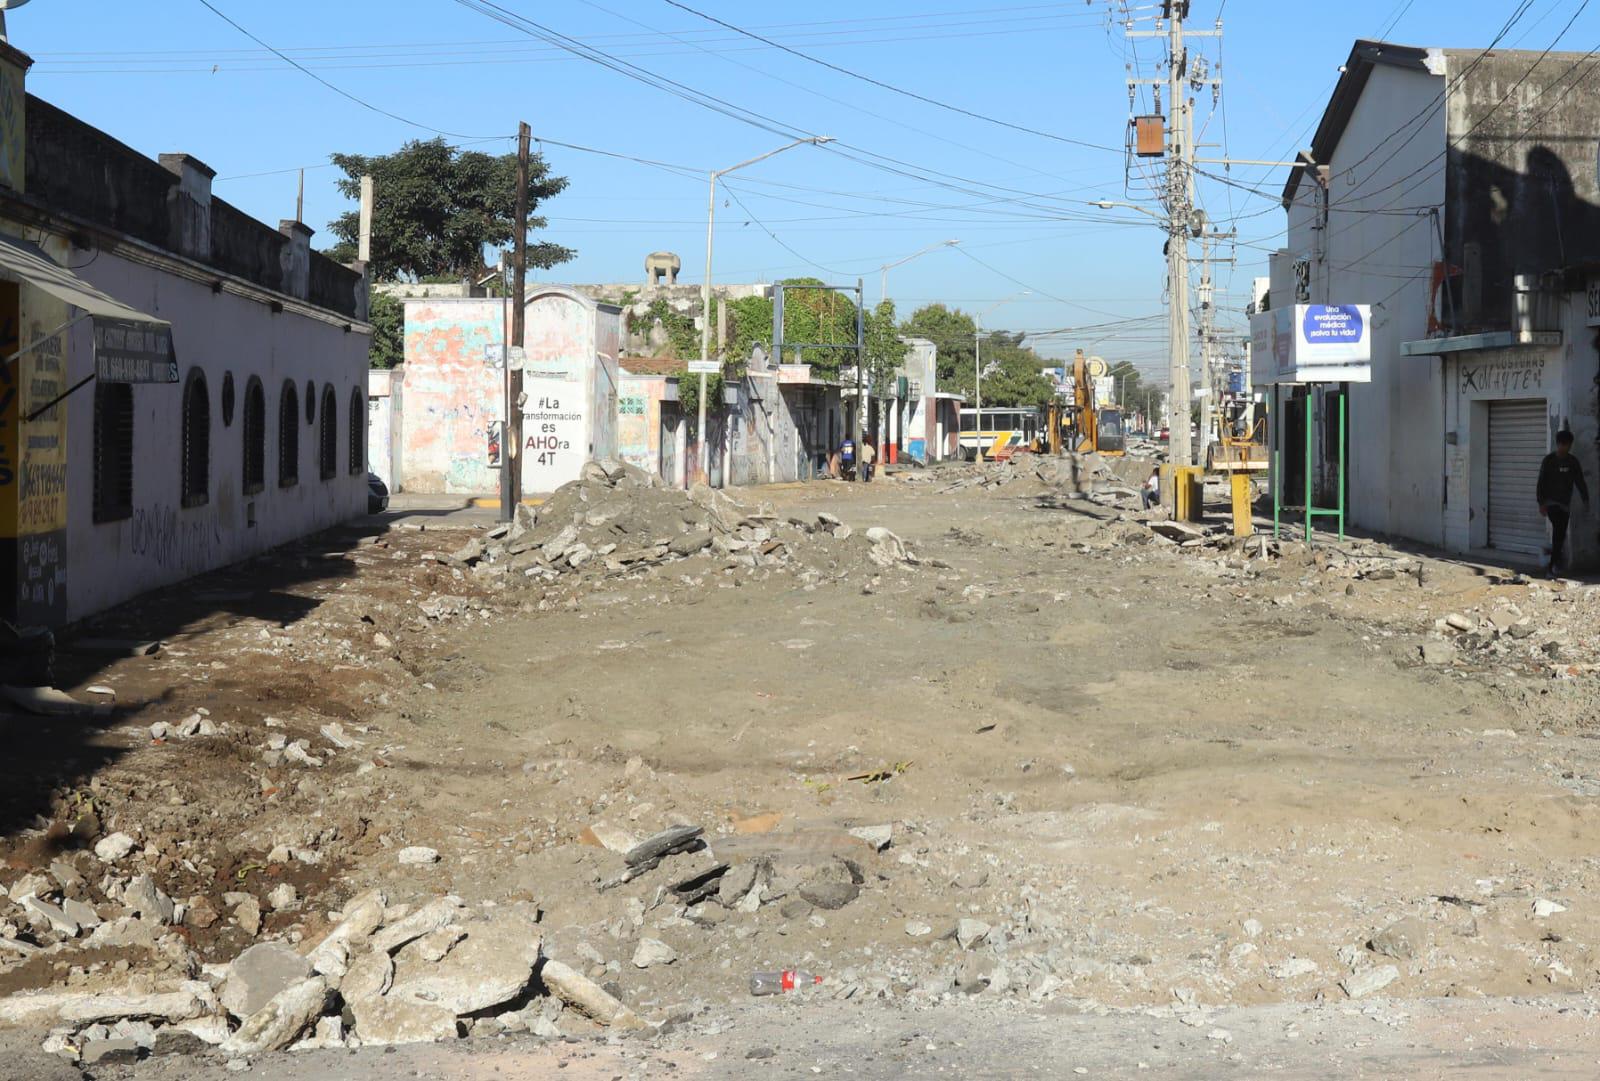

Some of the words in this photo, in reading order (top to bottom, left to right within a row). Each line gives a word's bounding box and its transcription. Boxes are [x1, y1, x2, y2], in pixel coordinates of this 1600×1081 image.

[1314, 313, 1352, 321] evaluación
[1319, 321, 1346, 329] médica
[1331, 329, 1338, 337] tu
[1339, 329, 1356, 337] vida!
[538, 397, 560, 409] #La
[541, 423, 556, 433] es
[525, 436, 570, 450] AHOra
[537, 452, 556, 466] 4T
